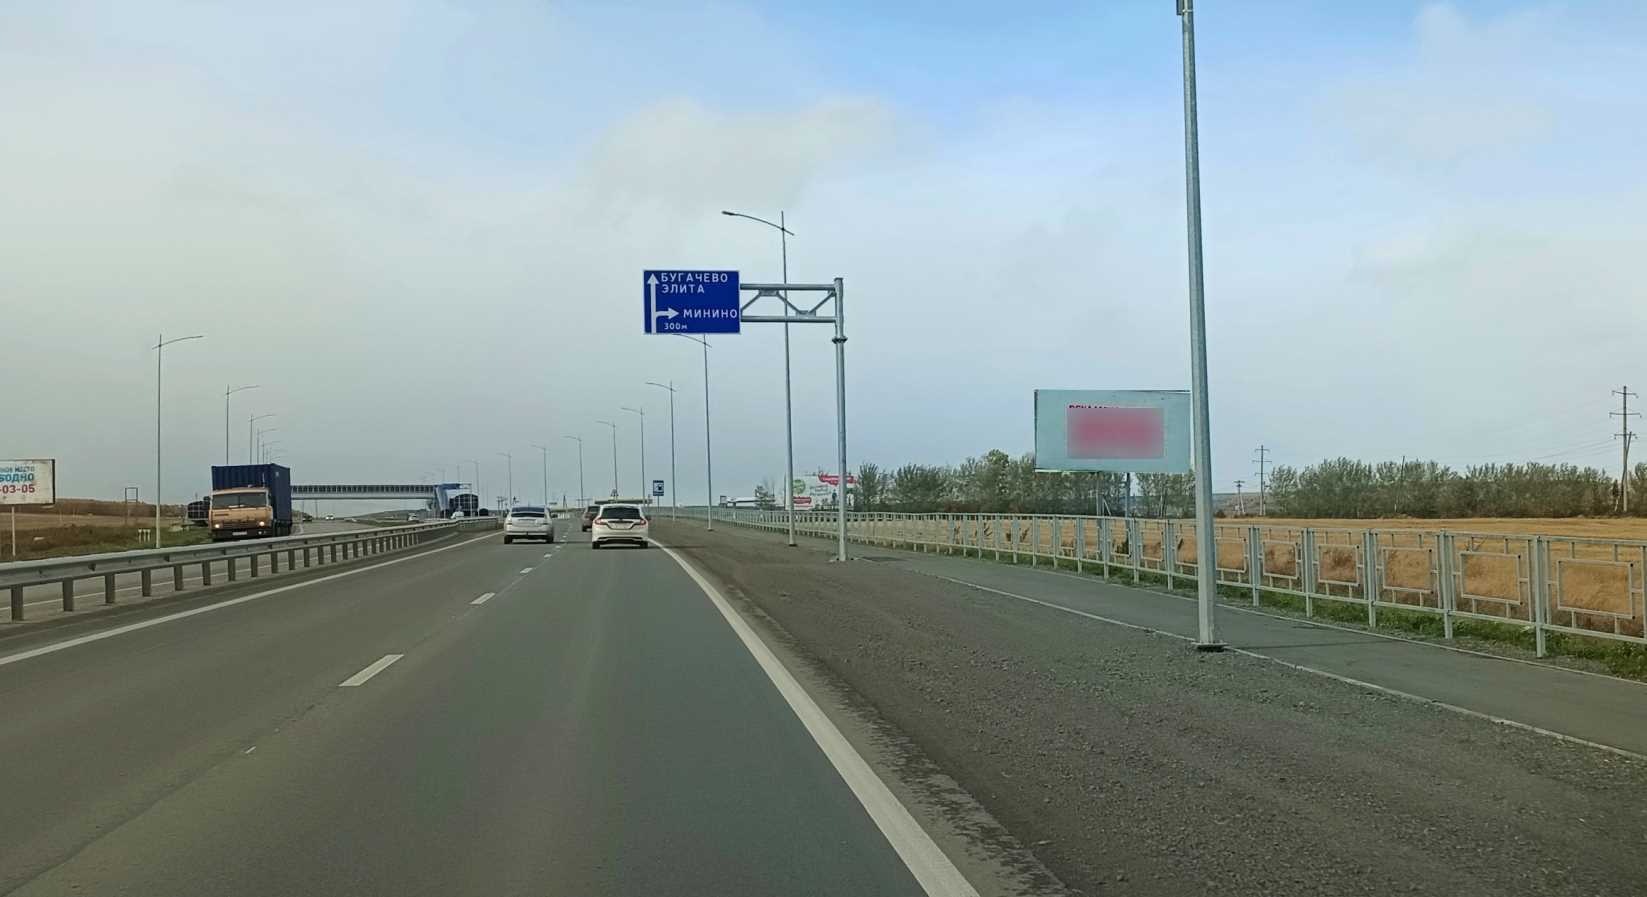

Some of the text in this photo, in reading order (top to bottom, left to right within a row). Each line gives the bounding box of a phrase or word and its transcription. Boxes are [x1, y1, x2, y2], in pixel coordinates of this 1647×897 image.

[661, 272, 728, 283] БУГАЧЕВО
[661, 284, 705, 294] ЭЛИТА
[683, 308, 738, 319] МИНИНО
